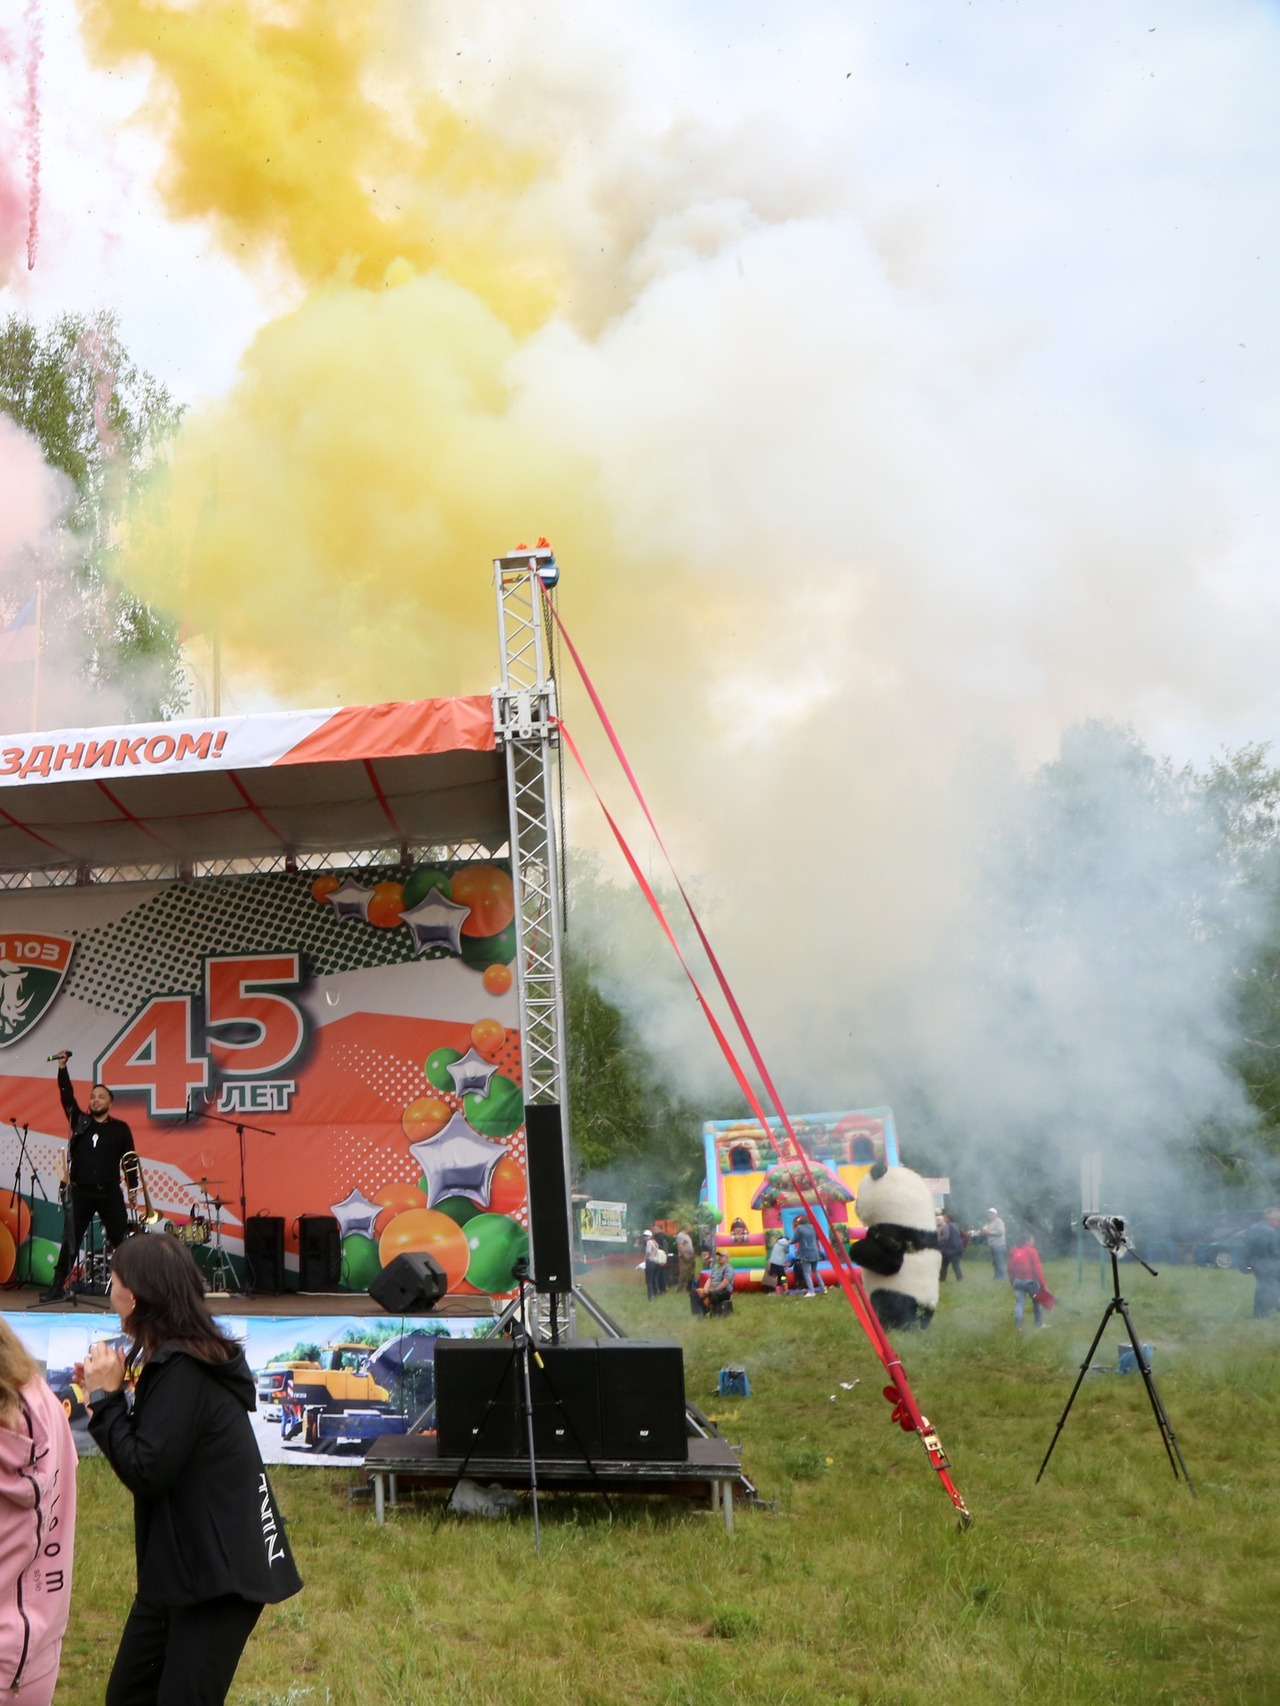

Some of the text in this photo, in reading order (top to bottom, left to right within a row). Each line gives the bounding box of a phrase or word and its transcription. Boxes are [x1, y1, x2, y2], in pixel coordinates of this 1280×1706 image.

[13, 941, 61, 961] 103
[94, 950, 306, 1118] 45
[218, 1080, 295, 1112] ЛЕТ
